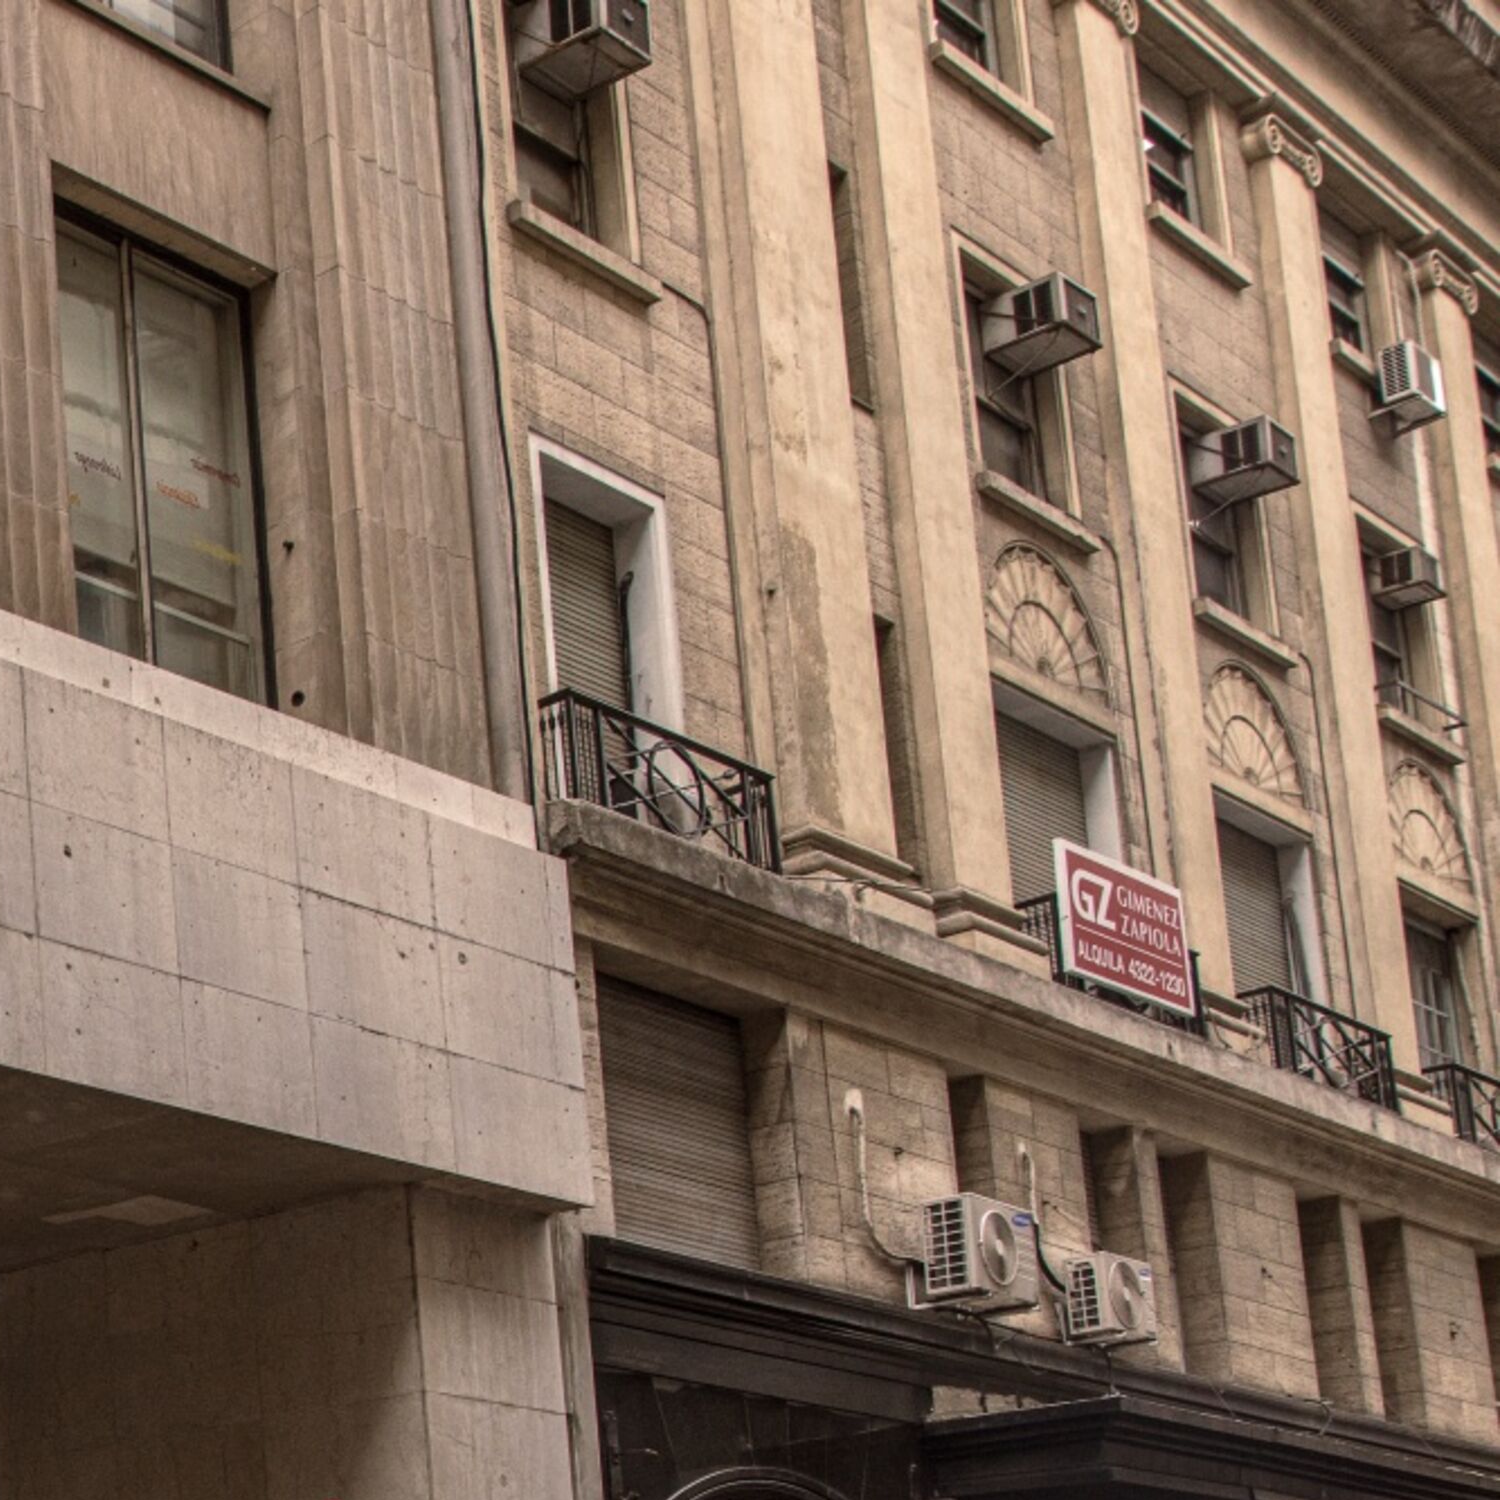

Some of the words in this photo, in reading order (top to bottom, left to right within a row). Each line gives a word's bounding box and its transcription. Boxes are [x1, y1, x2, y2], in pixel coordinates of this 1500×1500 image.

[1071, 867, 1116, 931] GZ
[1116, 885, 1180, 930] GIMENEZ
[1120, 914, 1182, 957] ZAPIOLA
[1078, 939, 1125, 974] ALQUILA
[1128, 959, 1186, 998] 4322-1230
